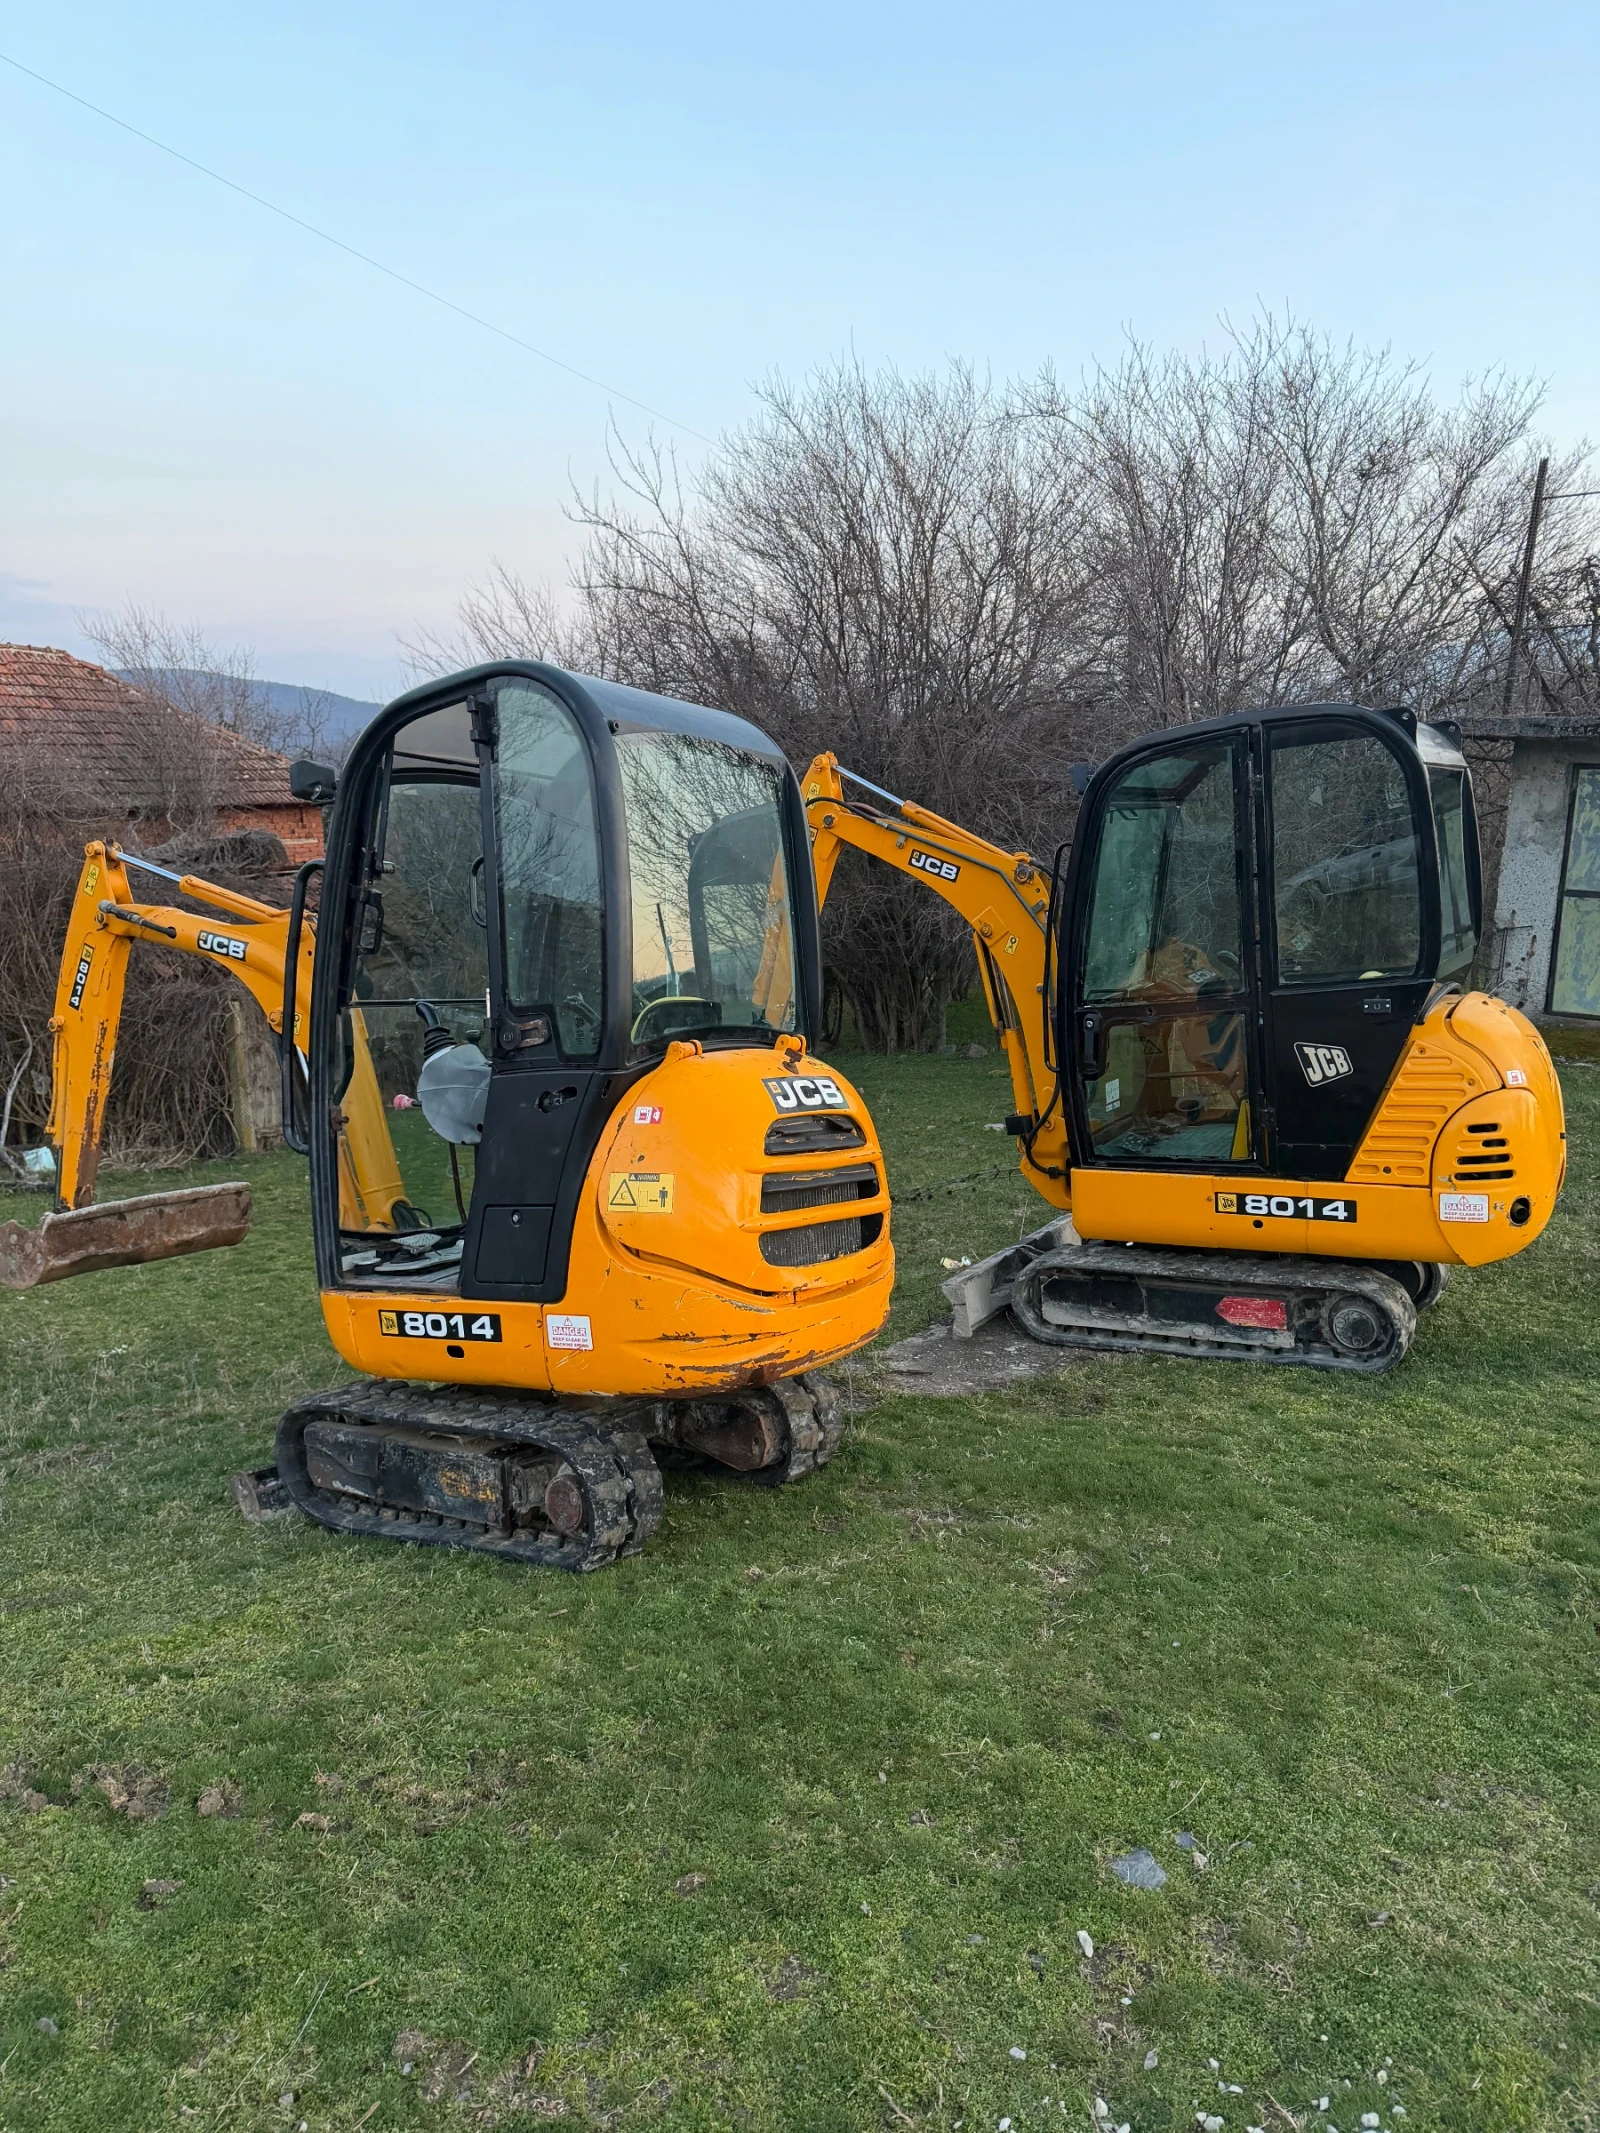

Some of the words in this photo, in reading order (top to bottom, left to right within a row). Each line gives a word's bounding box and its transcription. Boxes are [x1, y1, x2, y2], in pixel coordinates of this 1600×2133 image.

[911, 855, 957, 880] JCB
[198, 934, 245, 959] JCB
[71, 961, 89, 1007] 8014
[1303, 1046, 1350, 1082] JCB
[776, 1079, 844, 1108] JCB
[1245, 1195, 1348, 1220] 8014
[1446, 1203, 1483, 1211] DANGER
[403, 1312, 494, 1340] 8014
[552, 1326, 586, 1337] DANGER
